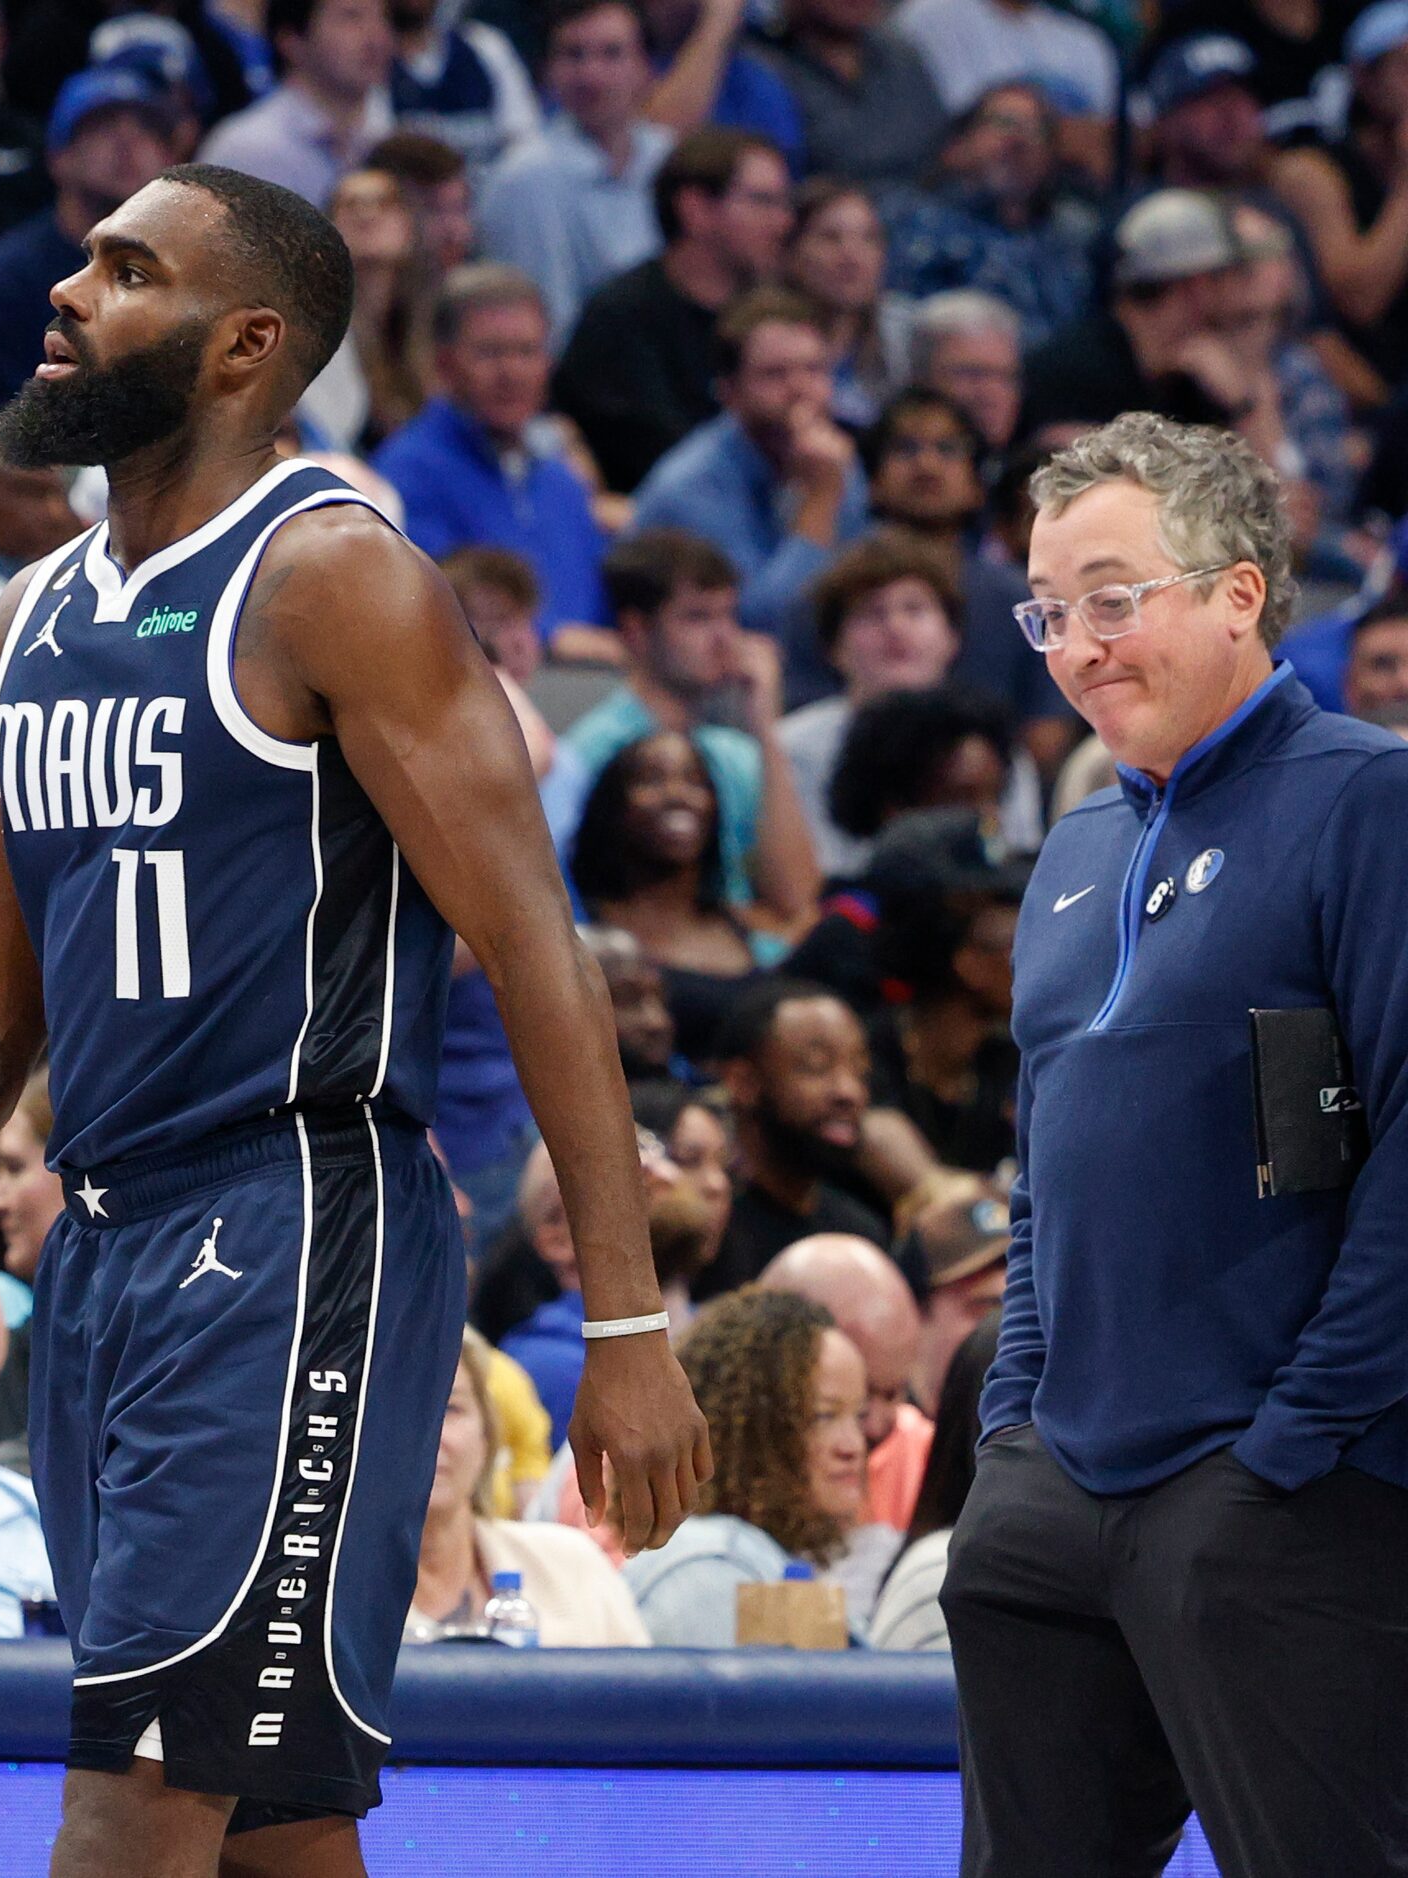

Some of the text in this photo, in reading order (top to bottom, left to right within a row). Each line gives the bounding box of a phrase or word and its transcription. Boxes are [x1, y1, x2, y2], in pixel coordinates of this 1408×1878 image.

[52, 562, 81, 591] 6
[135, 605, 198, 639] chime
[1146, 881, 1169, 914] 6
[111, 848, 191, 1000] 11
